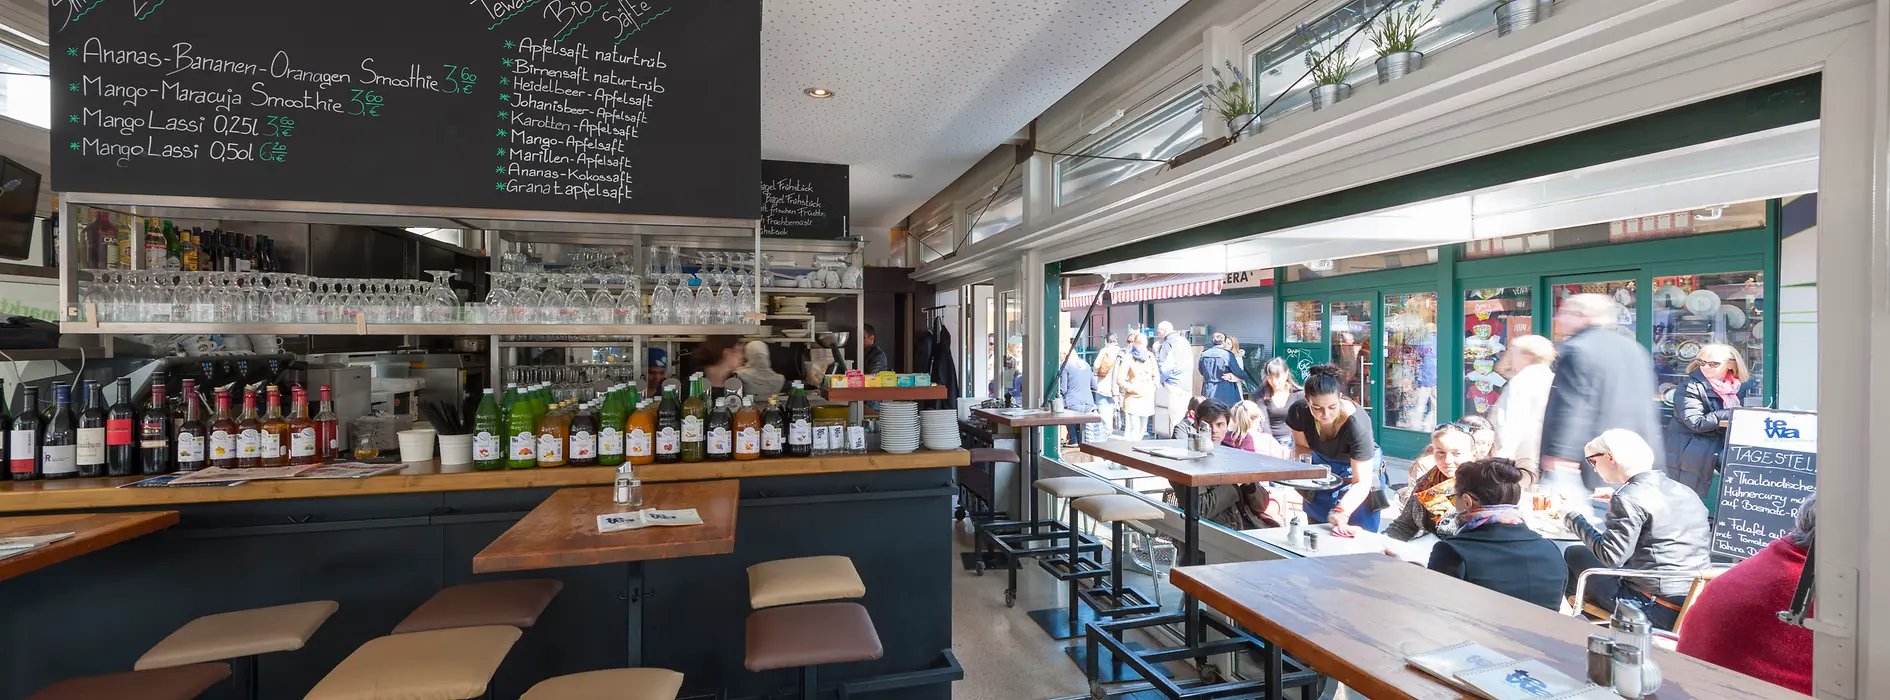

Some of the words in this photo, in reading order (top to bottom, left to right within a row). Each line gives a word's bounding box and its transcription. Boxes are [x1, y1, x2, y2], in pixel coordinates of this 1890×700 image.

[543, 0, 592, 38] Bio
[518, 37, 590, 65] Apfelsaft
[595, 45, 667, 69] naturtrüb
[359, 57, 439, 92] Smoothie
[511, 58, 590, 85] Birnensaft
[593, 70, 665, 94] naturtrüb
[82, 75, 242, 112] Mango-Maracuja
[250, 81, 345, 113] Smoothie
[83, 107, 145, 136] Mango
[148, 110, 206, 133] Lassi
[82, 137, 144, 168] Mango
[147, 136, 200, 159] Lassi
[1731, 446, 1817, 472] TAGESTEL
[1721, 500, 1738, 510] auf
[1723, 486, 1787, 507] Hühnercurry
[1715, 531, 1732, 539] mit
[1727, 517, 1766, 537] Falafel
